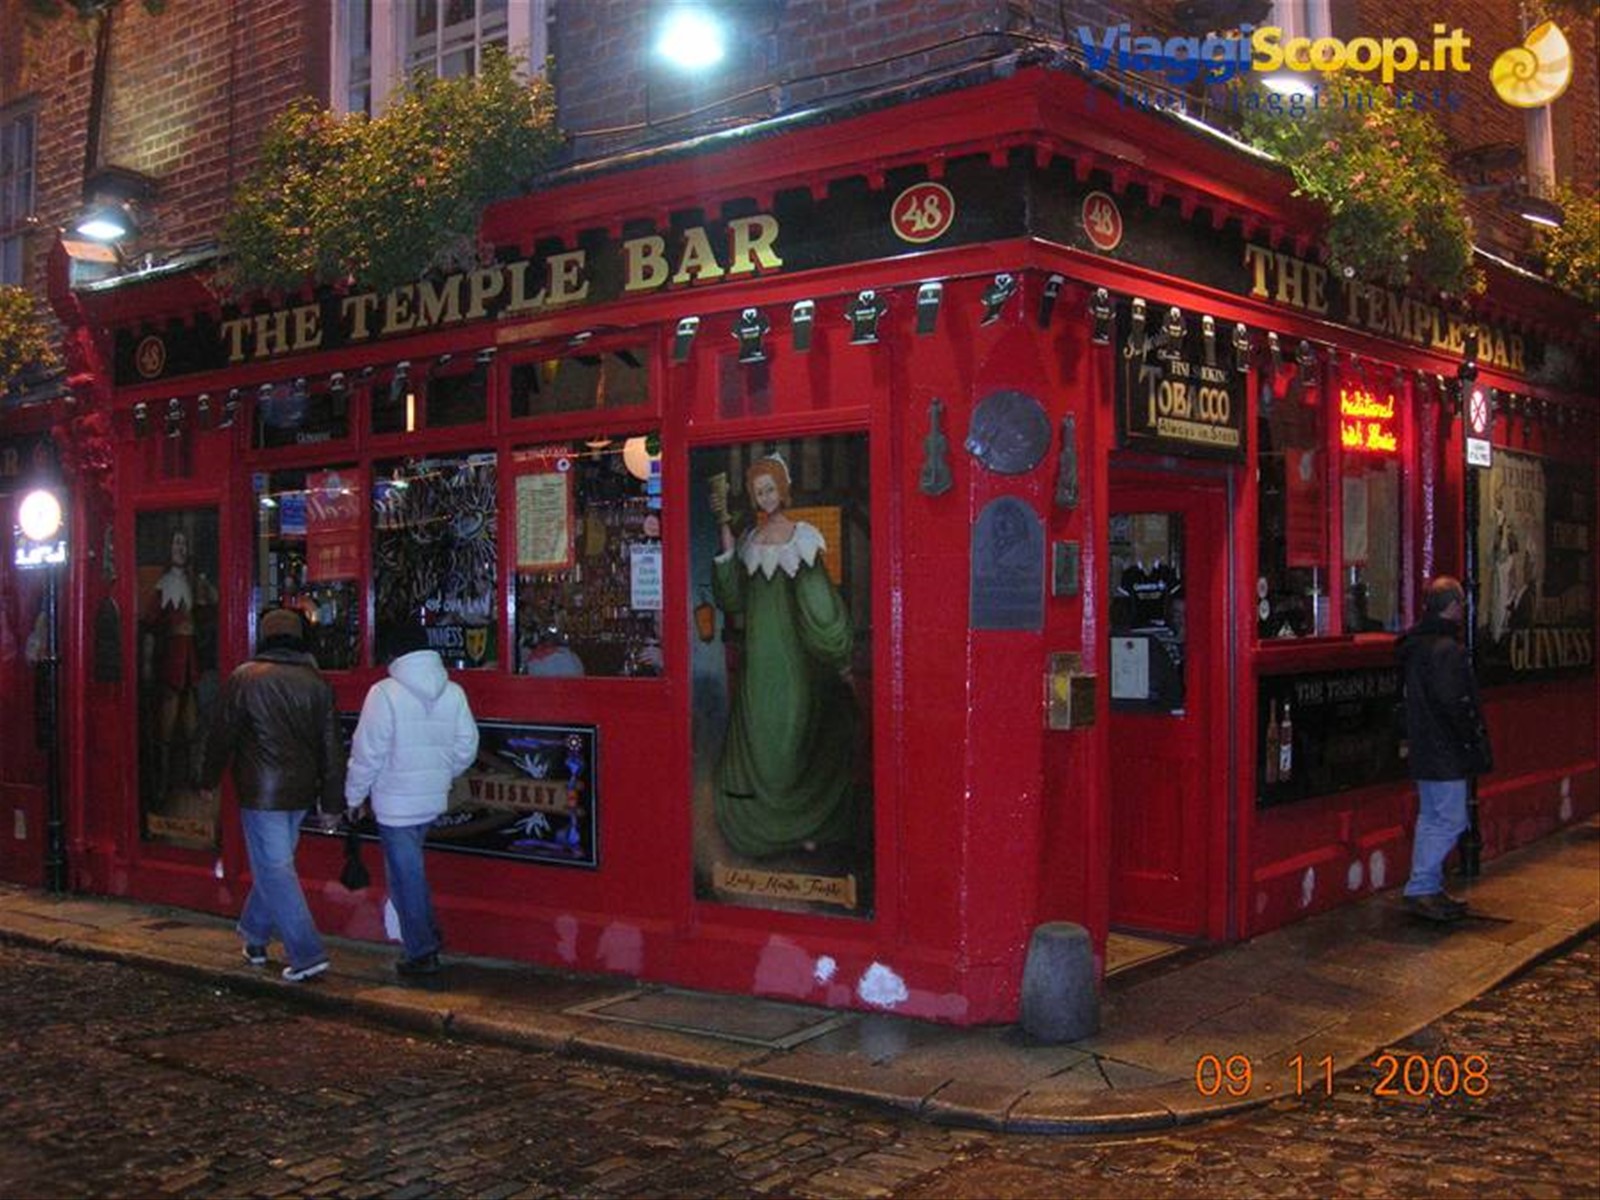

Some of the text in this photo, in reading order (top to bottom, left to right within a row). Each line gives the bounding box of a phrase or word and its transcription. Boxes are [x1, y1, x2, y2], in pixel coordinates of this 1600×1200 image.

[901, 194, 943, 232] 48
[1089, 200, 1114, 235] 48
[222, 214, 783, 361] THE TEMPLE BAR
[1246, 243, 1525, 373] THE TEMPLE BAR
[469, 778, 557, 806] WHISKEY
